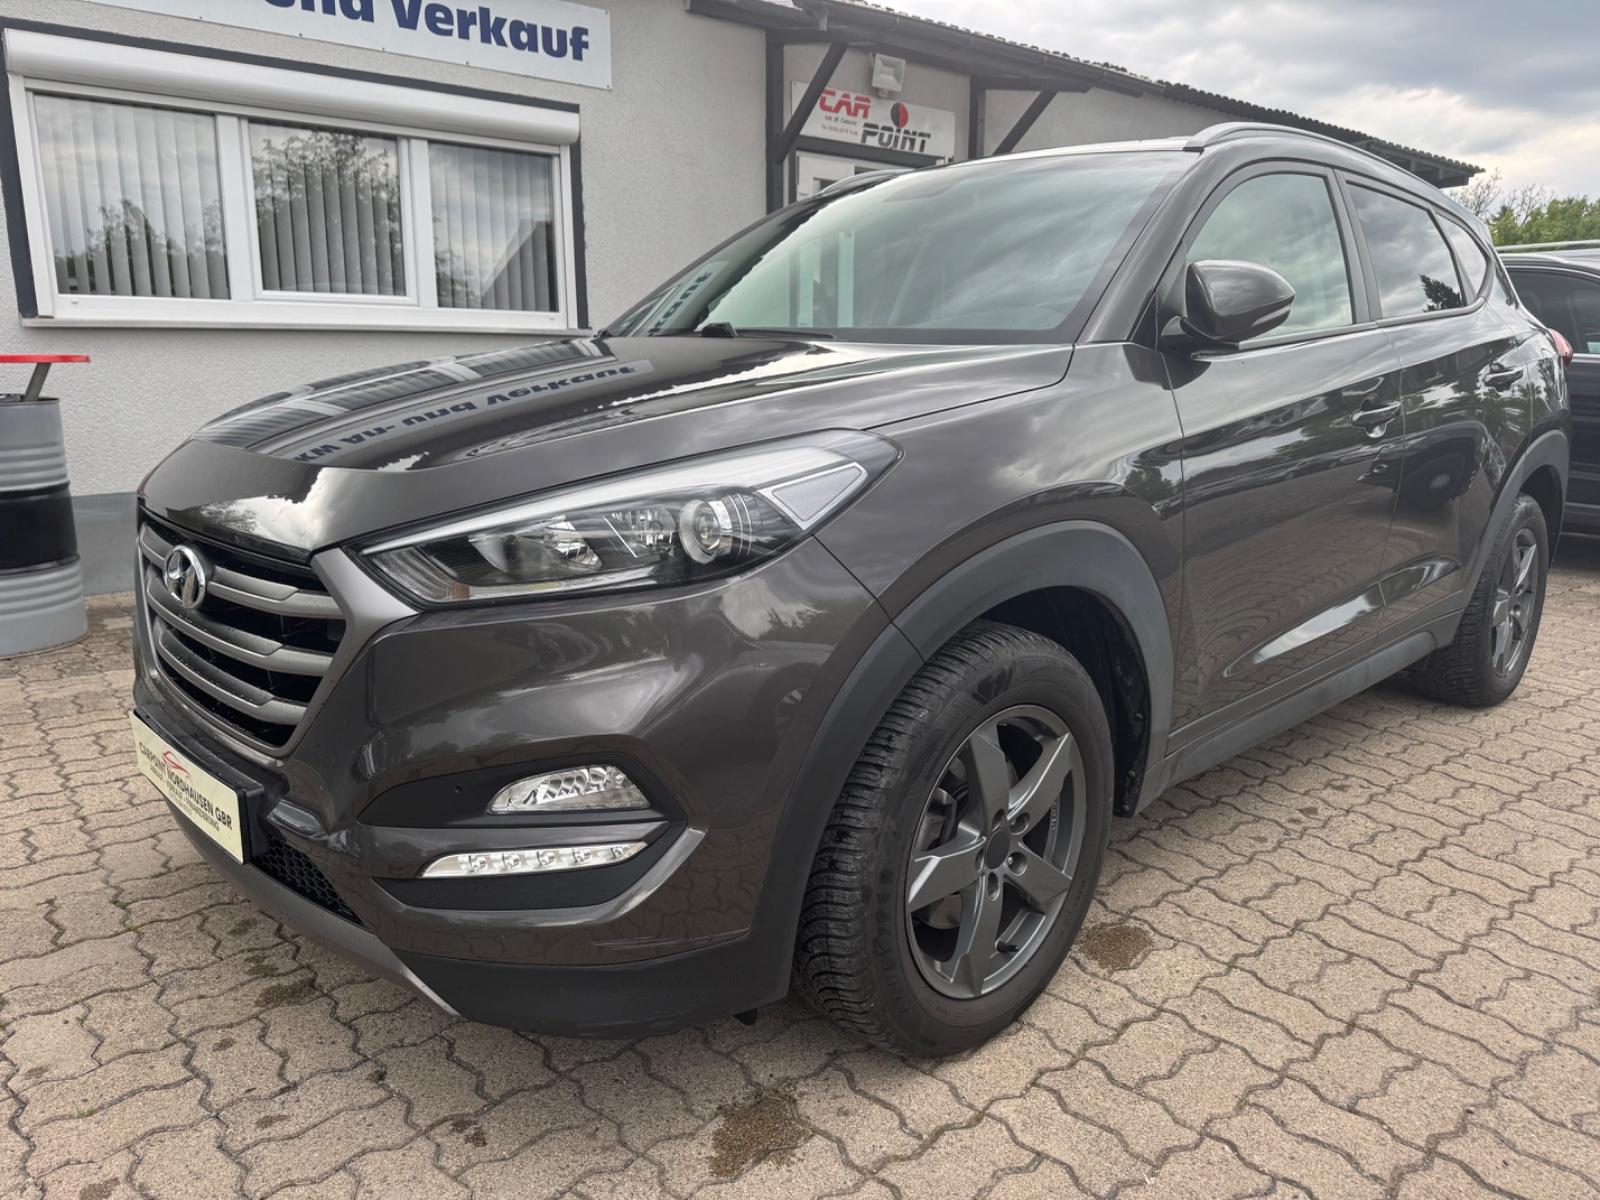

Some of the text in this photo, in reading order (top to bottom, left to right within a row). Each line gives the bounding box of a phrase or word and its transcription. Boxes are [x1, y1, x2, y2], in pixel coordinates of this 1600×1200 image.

[390, 0, 589, 61] Verkauf
[819, 87, 871, 119] CAR
[861, 121, 931, 153] POINT
[215, 806, 232, 830] GBR
